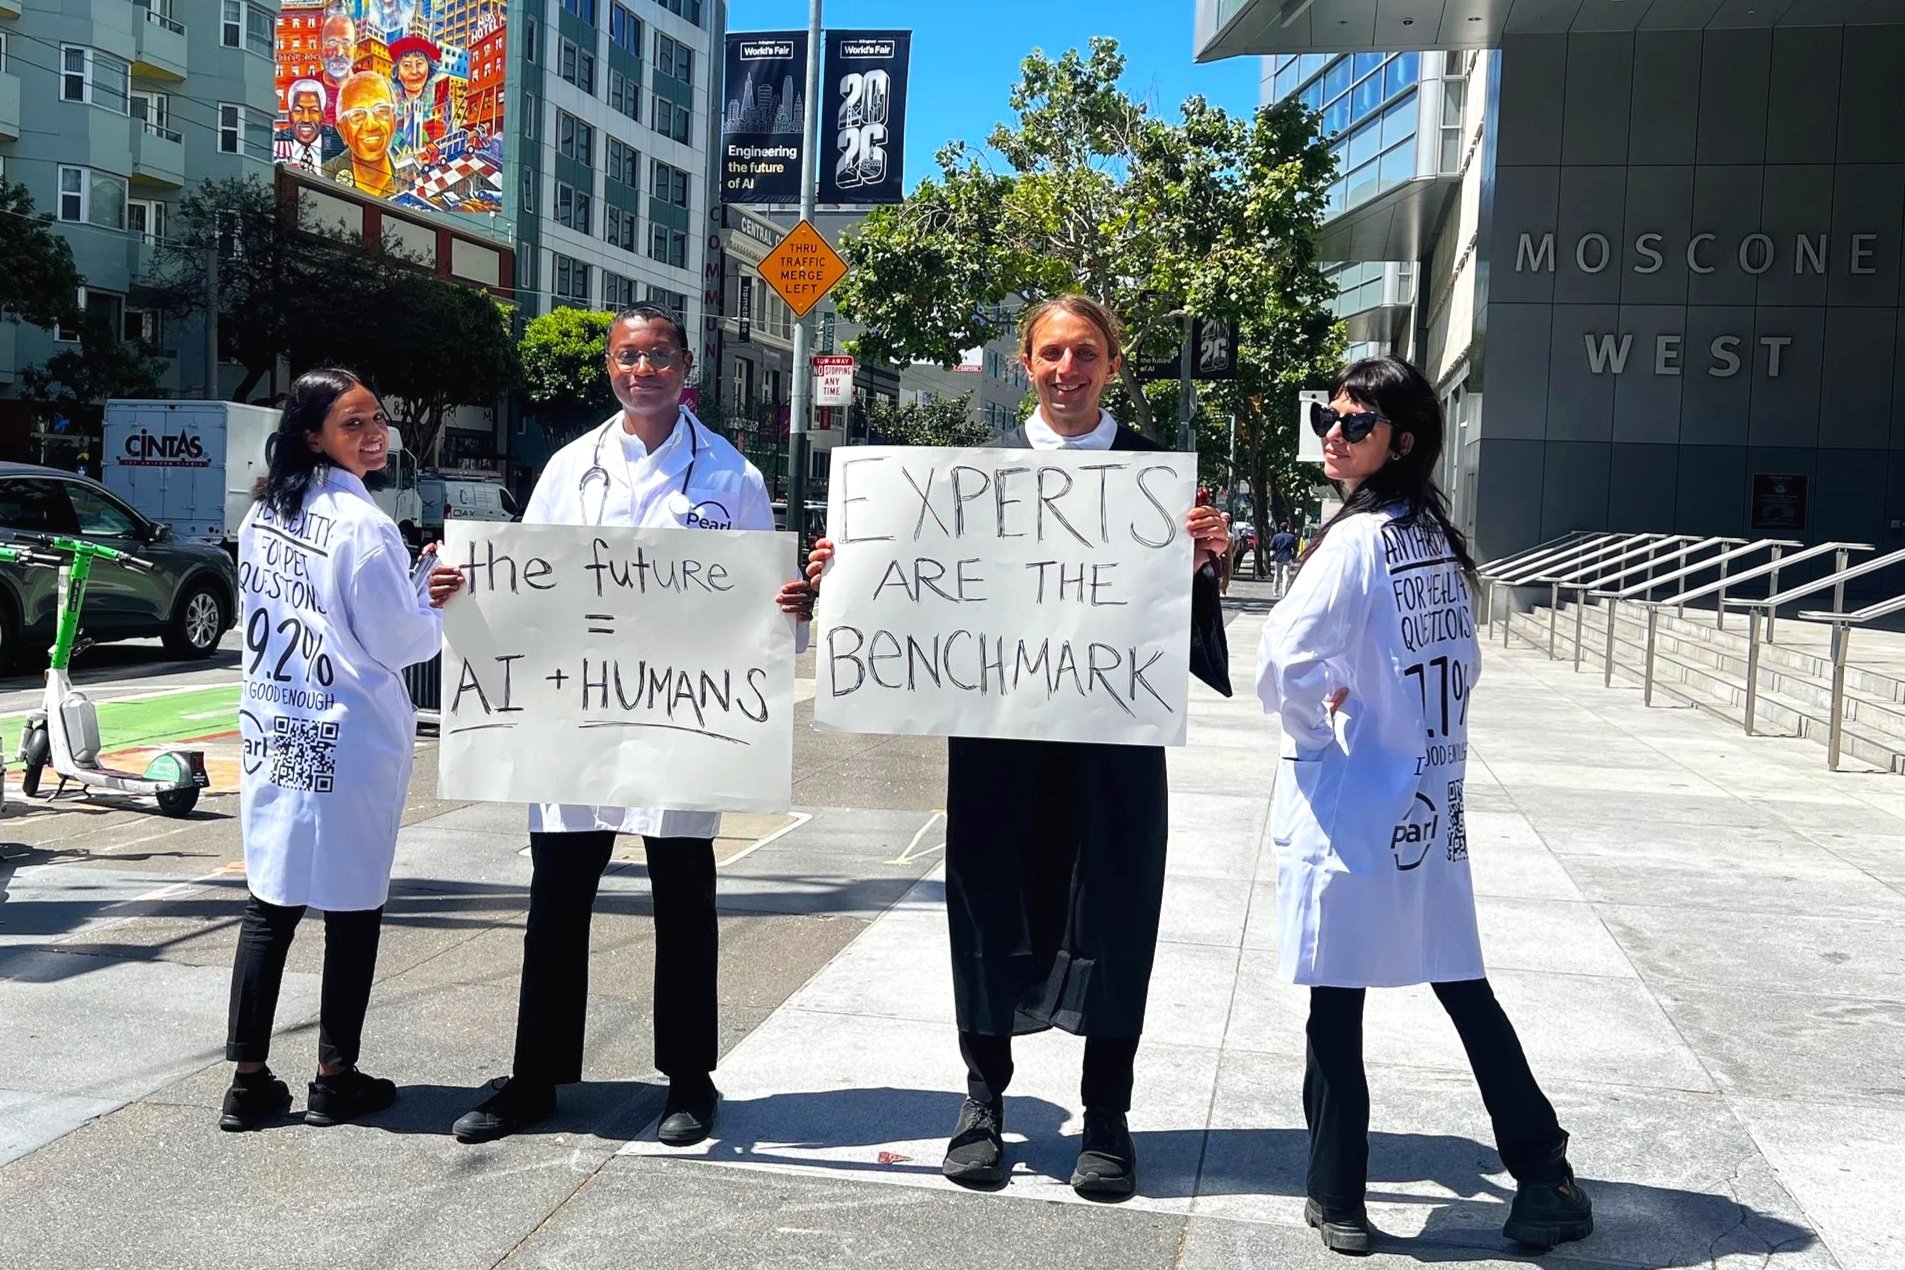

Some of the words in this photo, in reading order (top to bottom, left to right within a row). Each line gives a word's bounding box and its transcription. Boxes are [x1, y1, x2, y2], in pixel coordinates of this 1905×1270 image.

[744, 45, 773, 57] World's
[775, 44, 790, 56] Fair
[844, 45, 874, 55] World's
[875, 44, 891, 55] Fair
[728, 145, 798, 160] Engineering
[728, 162, 748, 173] the
[749, 161, 785, 173] future
[728, 179, 740, 189] of
[742, 179, 755, 189] AI
[741, 216, 772, 246] CENTRAL
[790, 243, 818, 254] THRU
[1514, 232, 1878, 275] MOSCONE
[780, 257, 826, 267] TRAFFIC
[780, 270, 824, 281] MERGE
[785, 284, 818, 294] LEFT
[742, 286, 750, 334] homebse
[1584, 334, 1792, 377] WEST
[813, 366, 823, 376] NO
[825, 366, 852, 375] STOPPING
[824, 378, 840, 386] ANY
[823, 387, 840, 395] TIME
[839, 456, 1179, 549] EXPERTS
[459, 540, 558, 598] the
[873, 557, 988, 603] ARE
[1025, 561, 1128, 606] THE
[1393, 576, 1426, 612] FOR
[585, 614, 615, 634] =
[250, 682, 281, 702] GOOD
[282, 687, 335, 710] ENOUGH
[451, 655, 525, 716] AI
[545, 668, 569, 690] +
[582, 658, 769, 728] HUMANS
[244, 738, 267, 757] arl
